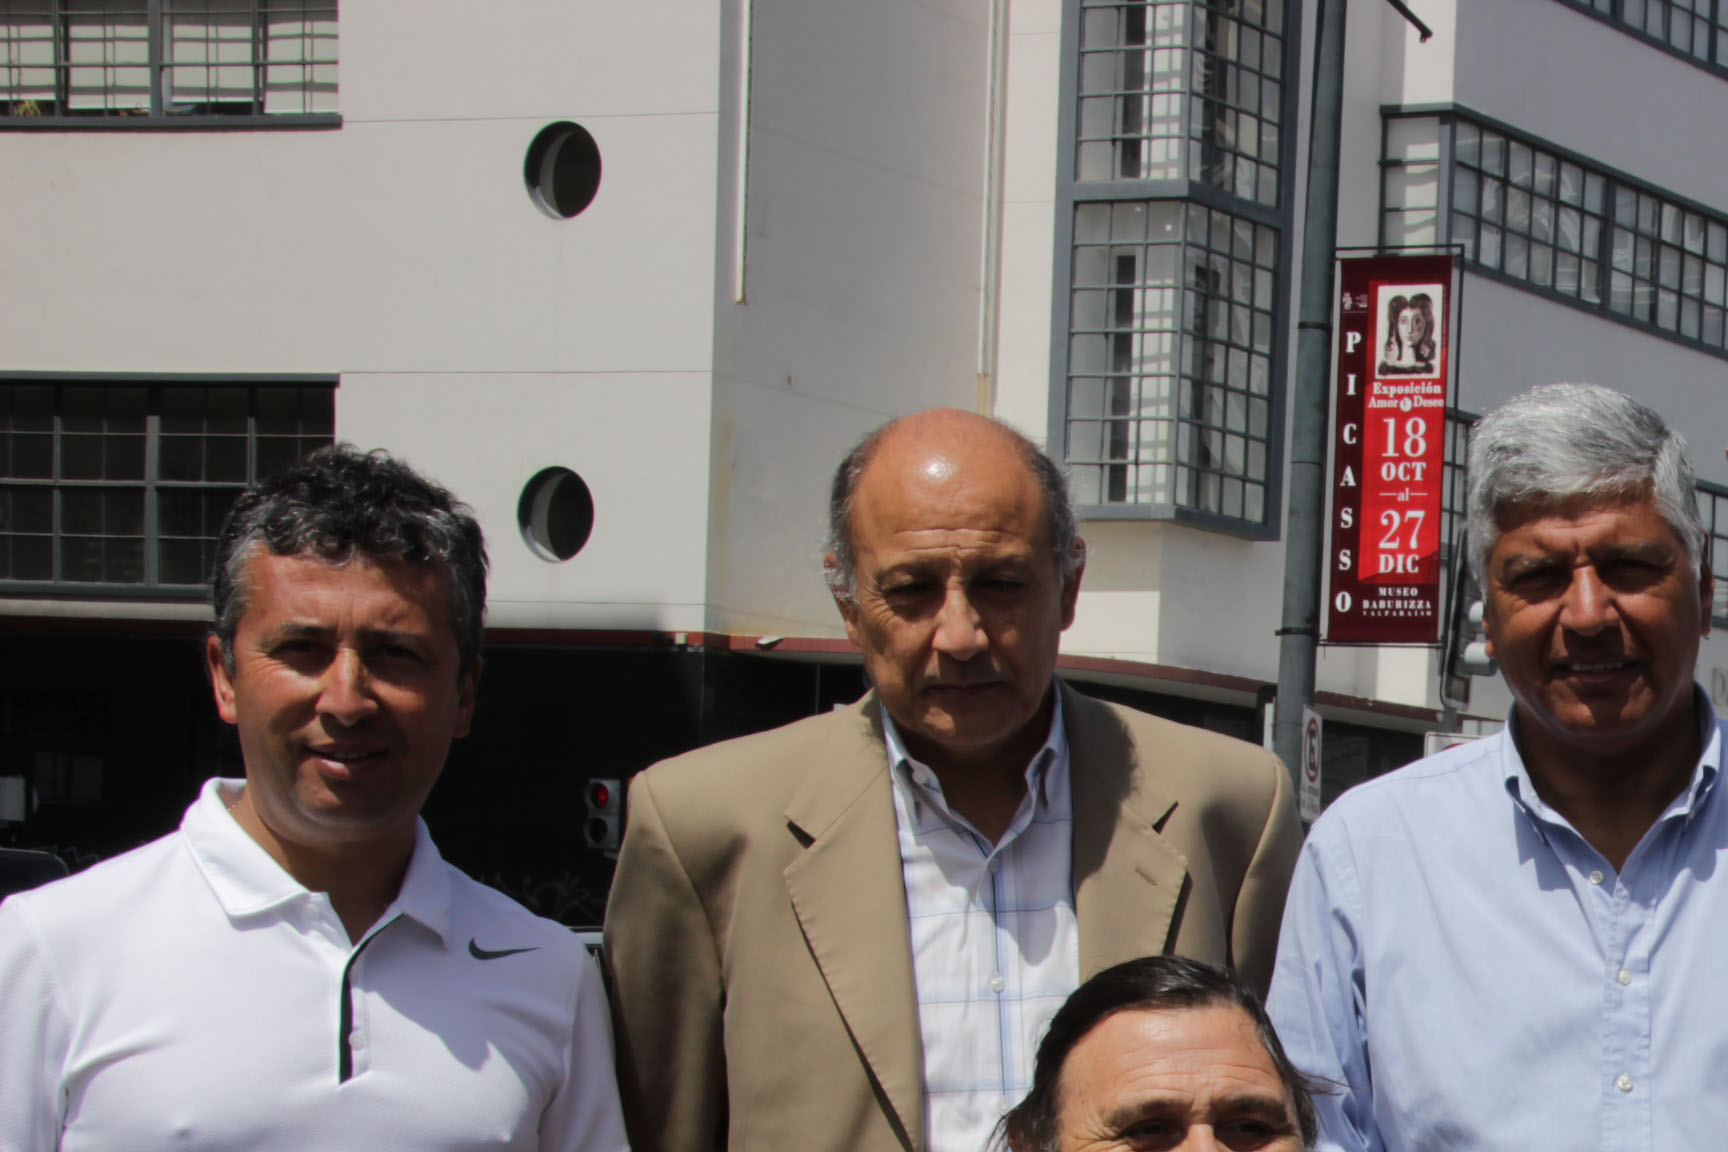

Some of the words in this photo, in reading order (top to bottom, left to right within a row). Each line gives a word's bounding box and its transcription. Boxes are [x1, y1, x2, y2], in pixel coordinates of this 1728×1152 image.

[1373, 381, 1442, 398] Exposición
[1368, 396, 1399, 408] Amor
[1413, 395, 1444, 408] Deseo
[1382, 417, 1427, 457] 18
[1335, 331, 1362, 613] PICASSO
[1381, 461, 1427, 481] OCT
[1378, 509, 1426, 550] 27
[1378, 553, 1420, 574] DIC
[1378, 587, 1418, 597] MUSEO
[1363, 599, 1432, 609] BABURIZZA
